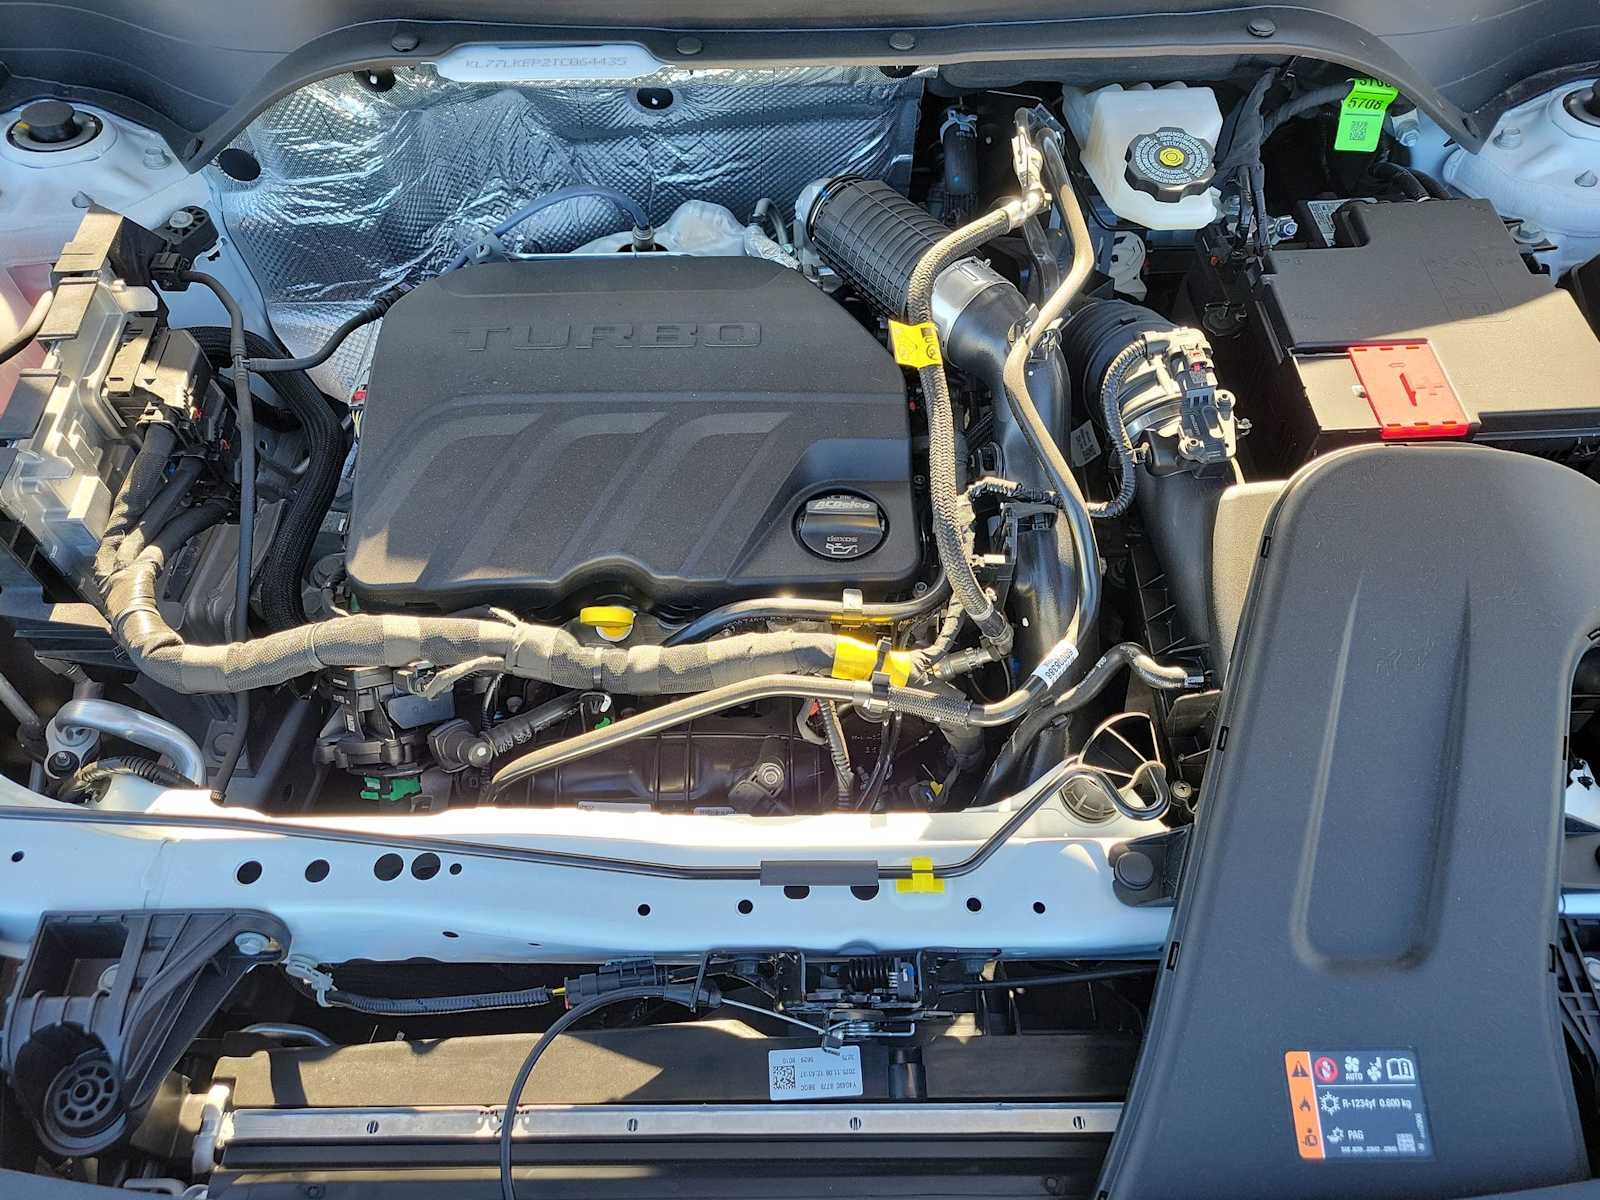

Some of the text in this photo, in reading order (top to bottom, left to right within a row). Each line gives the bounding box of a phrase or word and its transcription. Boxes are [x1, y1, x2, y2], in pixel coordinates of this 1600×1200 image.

[448, 322, 762, 351] TURBO
[827, 535, 858, 543] dexos
[1345, 1072, 1363, 1081] AUTO
[1401, 1098, 1412, 1110] kg
[1347, 1130, 1365, 1140] PAG
